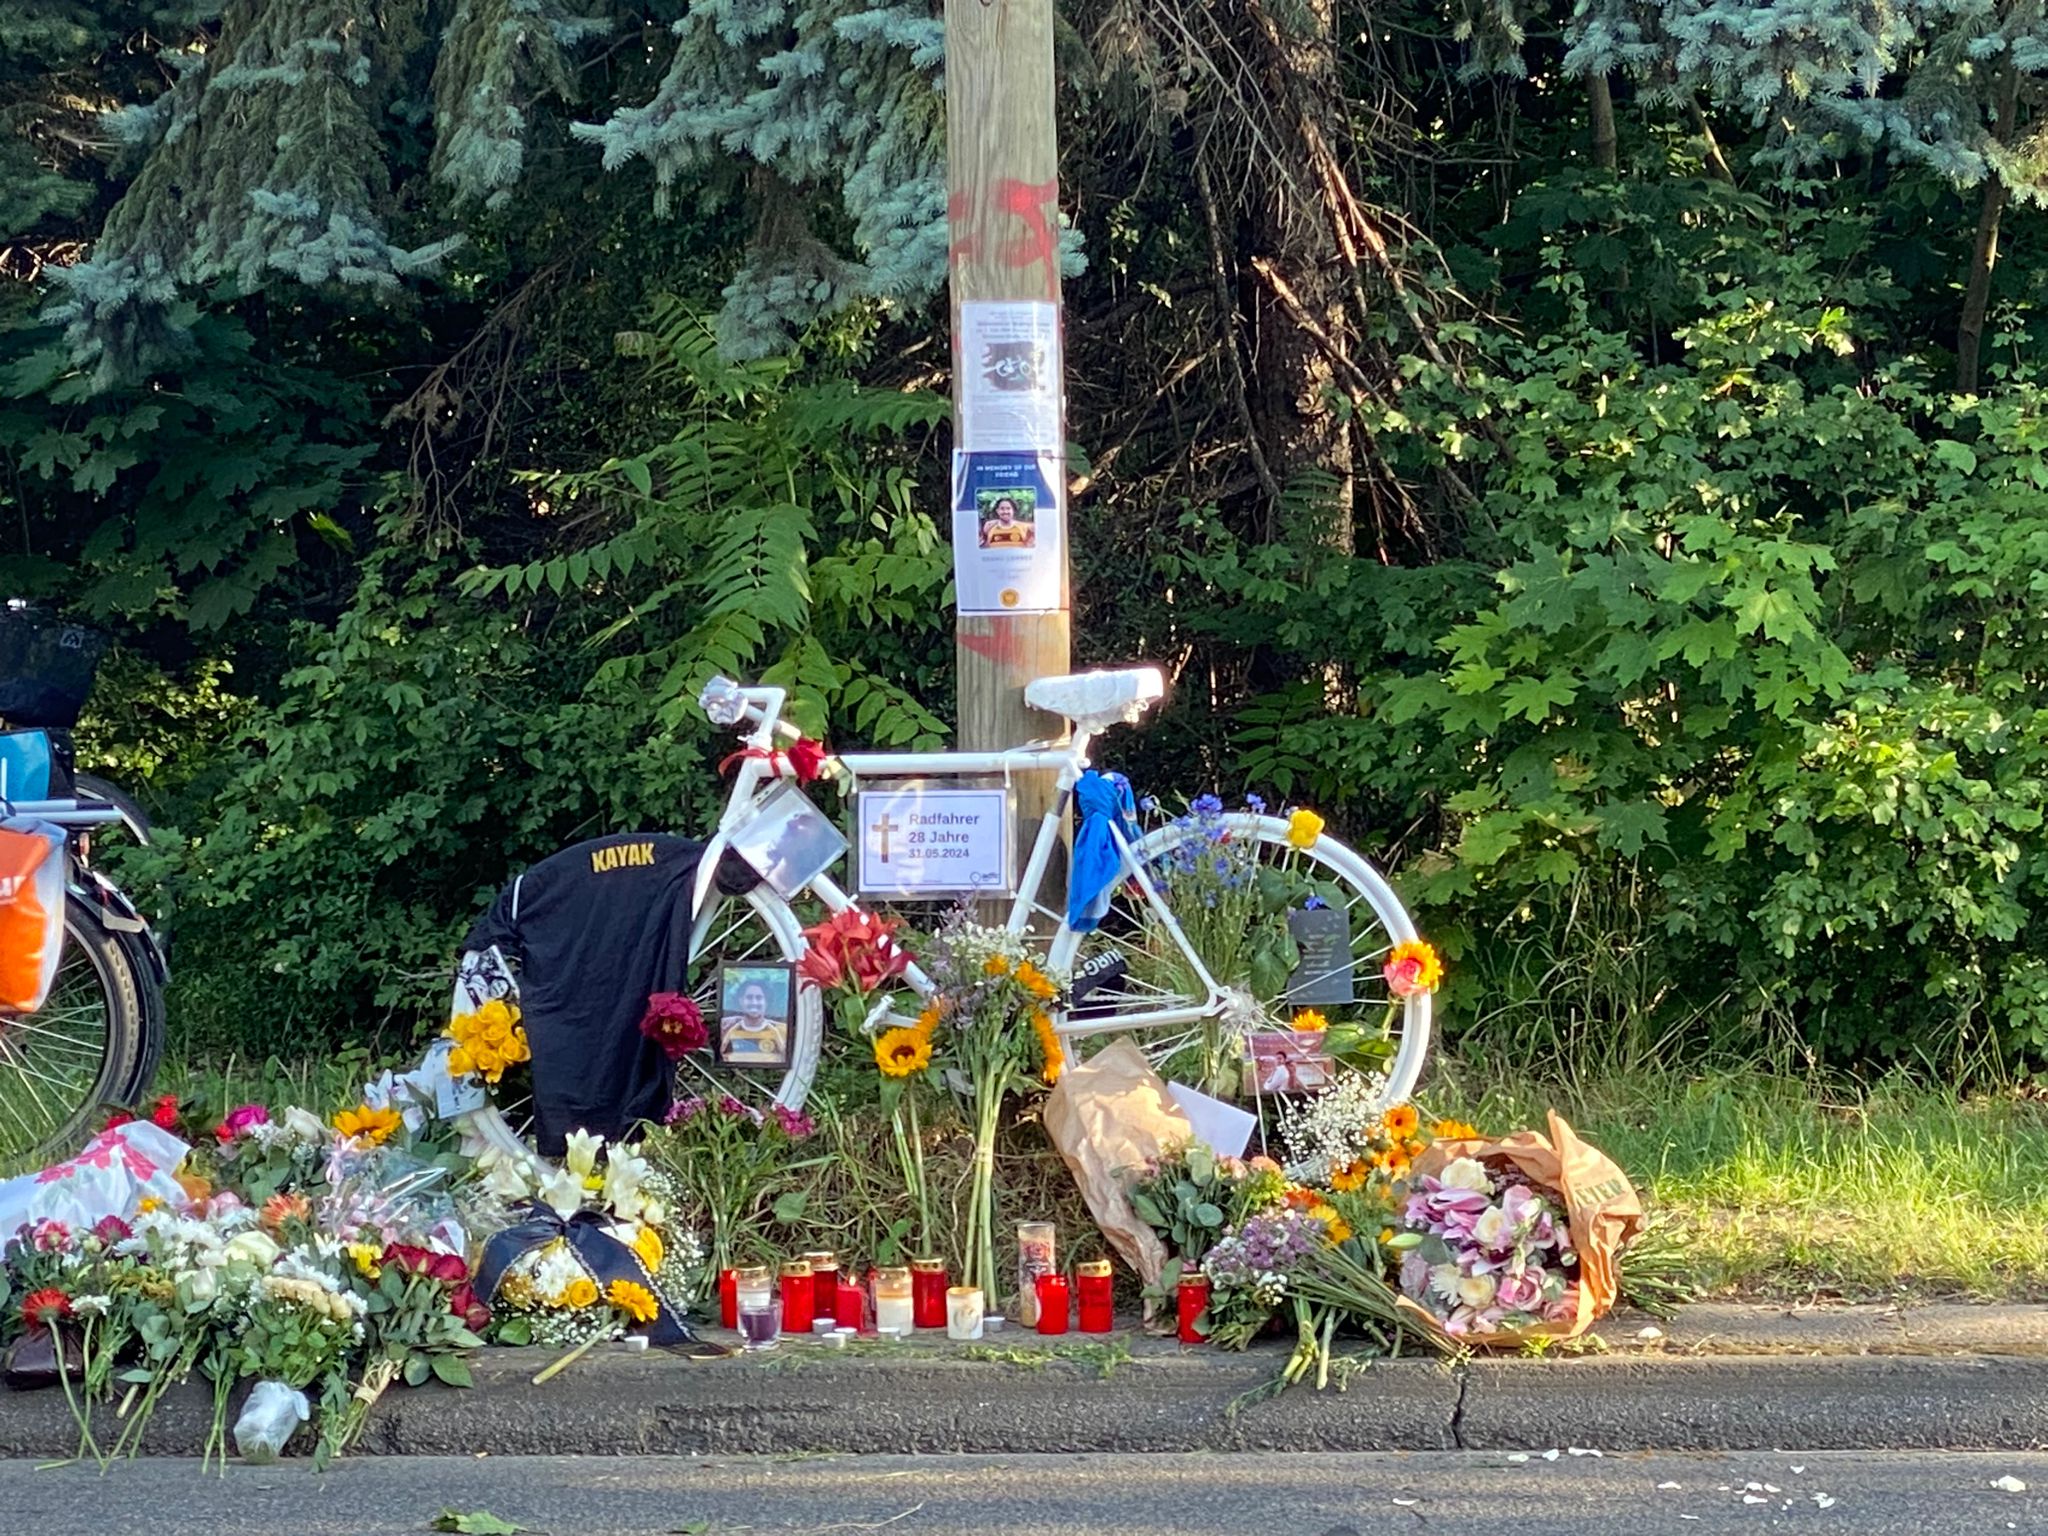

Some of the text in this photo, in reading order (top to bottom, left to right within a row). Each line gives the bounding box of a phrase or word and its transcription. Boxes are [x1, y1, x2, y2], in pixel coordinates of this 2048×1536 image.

[909, 812, 980, 825] Radfahrer
[908, 831, 969, 843] 28 Jahre
[592, 843, 656, 873] KAYAK
[908, 848, 970, 859] 31.05.2024
